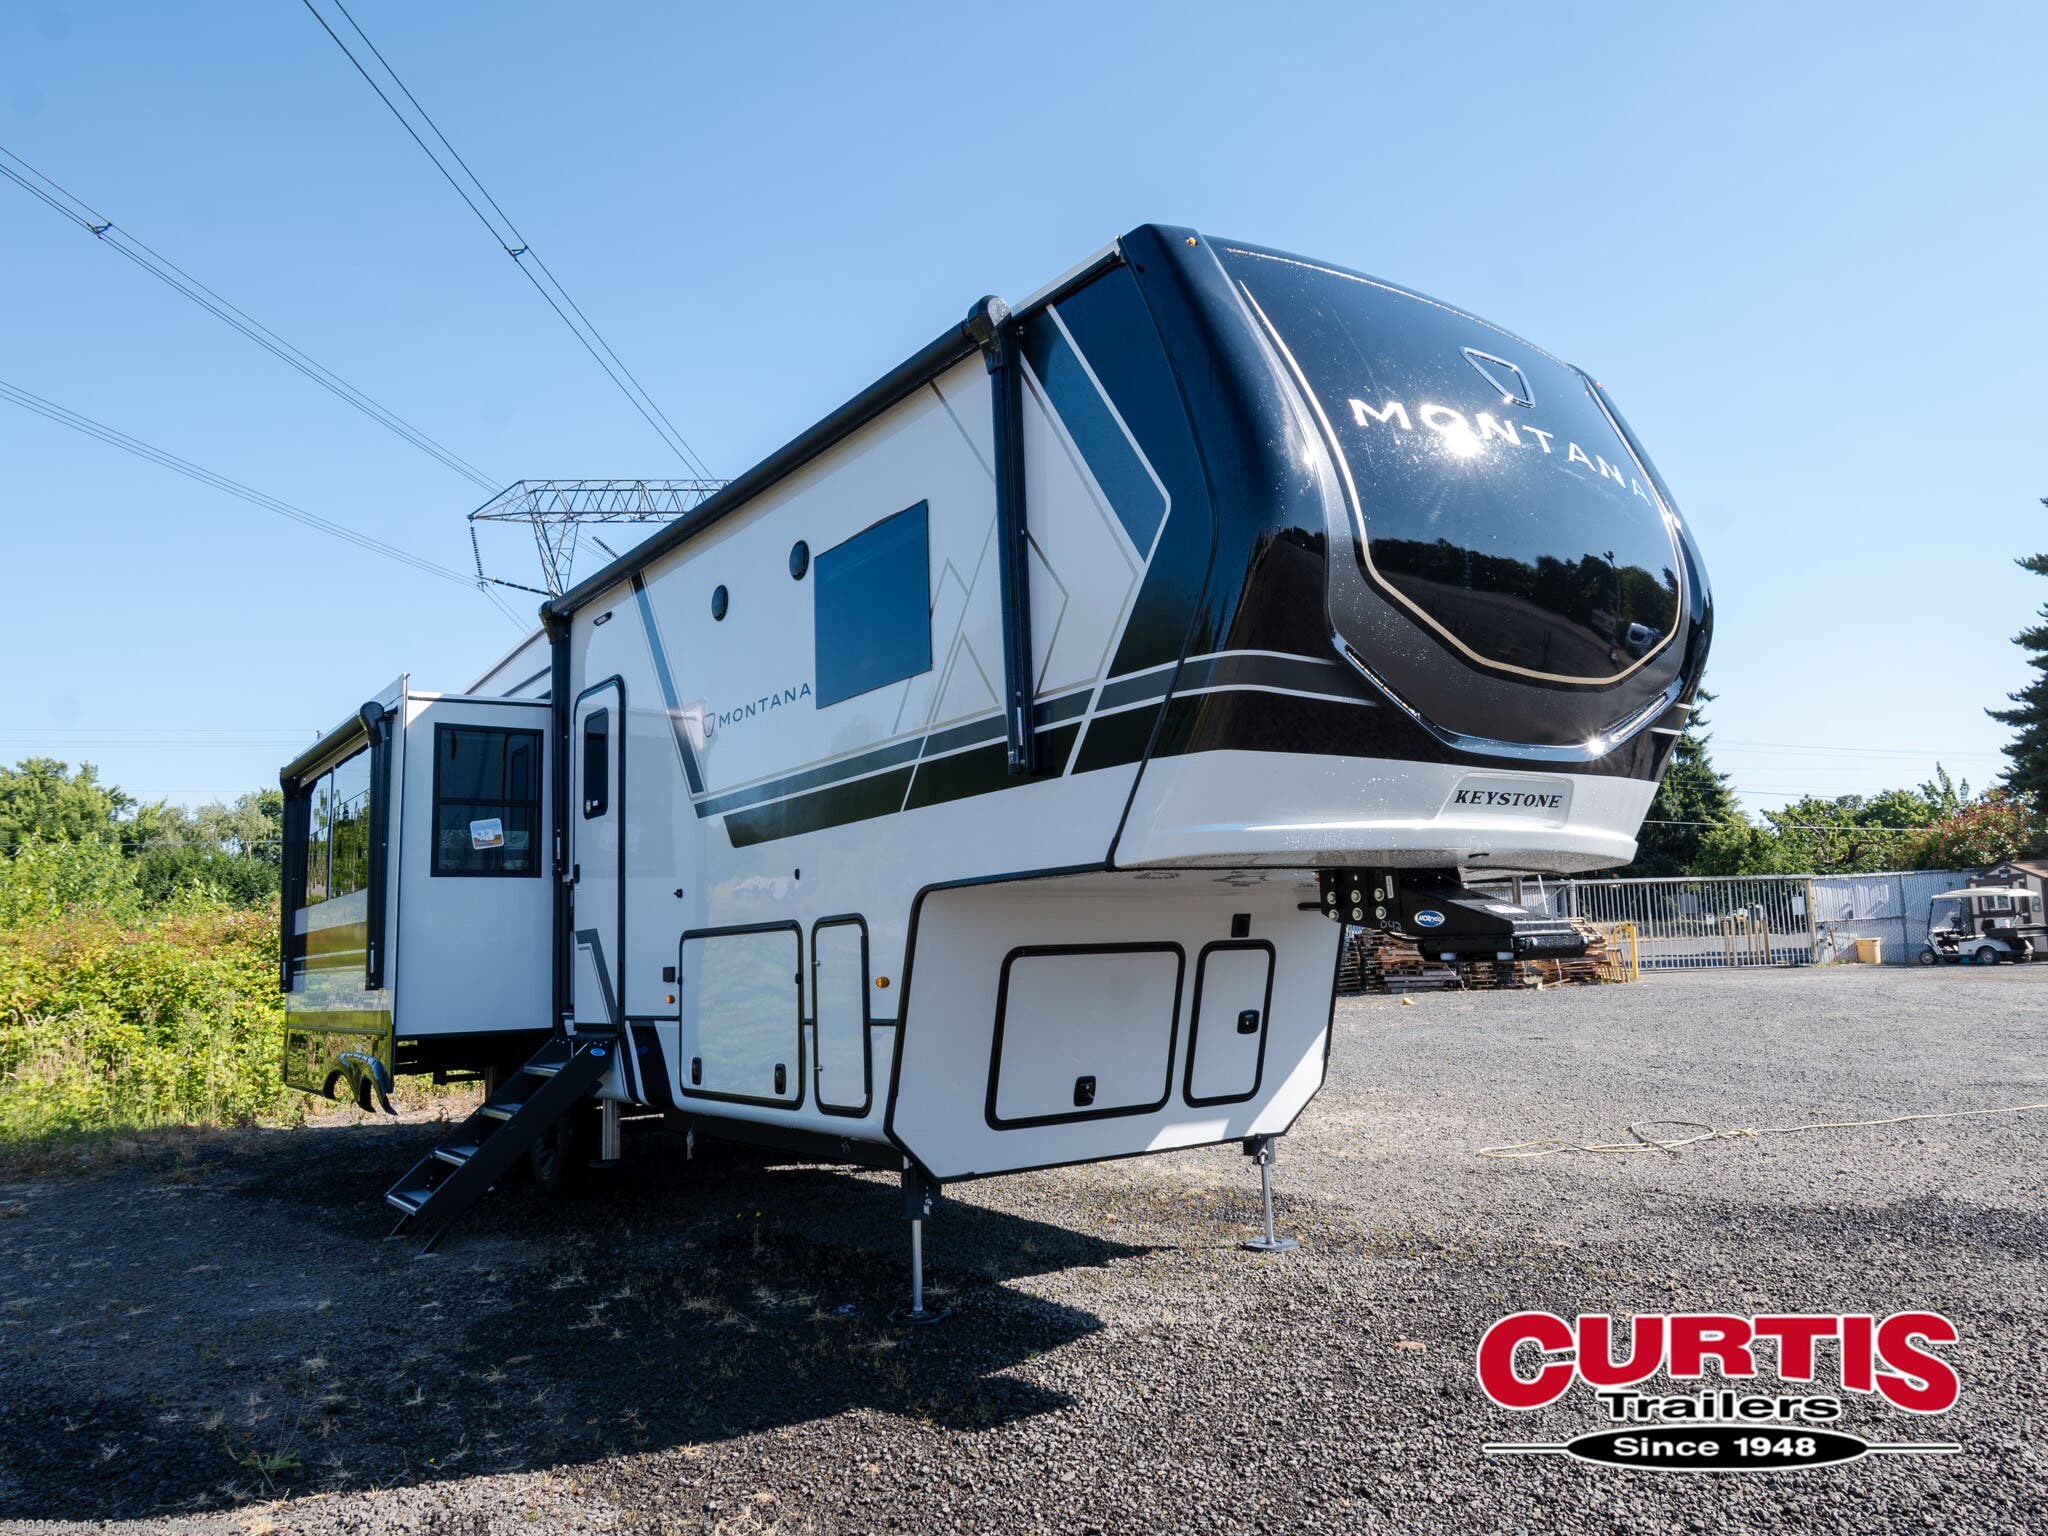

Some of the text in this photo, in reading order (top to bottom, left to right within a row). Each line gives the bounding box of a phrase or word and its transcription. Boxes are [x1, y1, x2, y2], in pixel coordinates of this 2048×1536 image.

[1348, 398, 1653, 508] MONTANA
[718, 683, 812, 728] MONTANA
[1454, 789, 1563, 808] KEYSTONE
